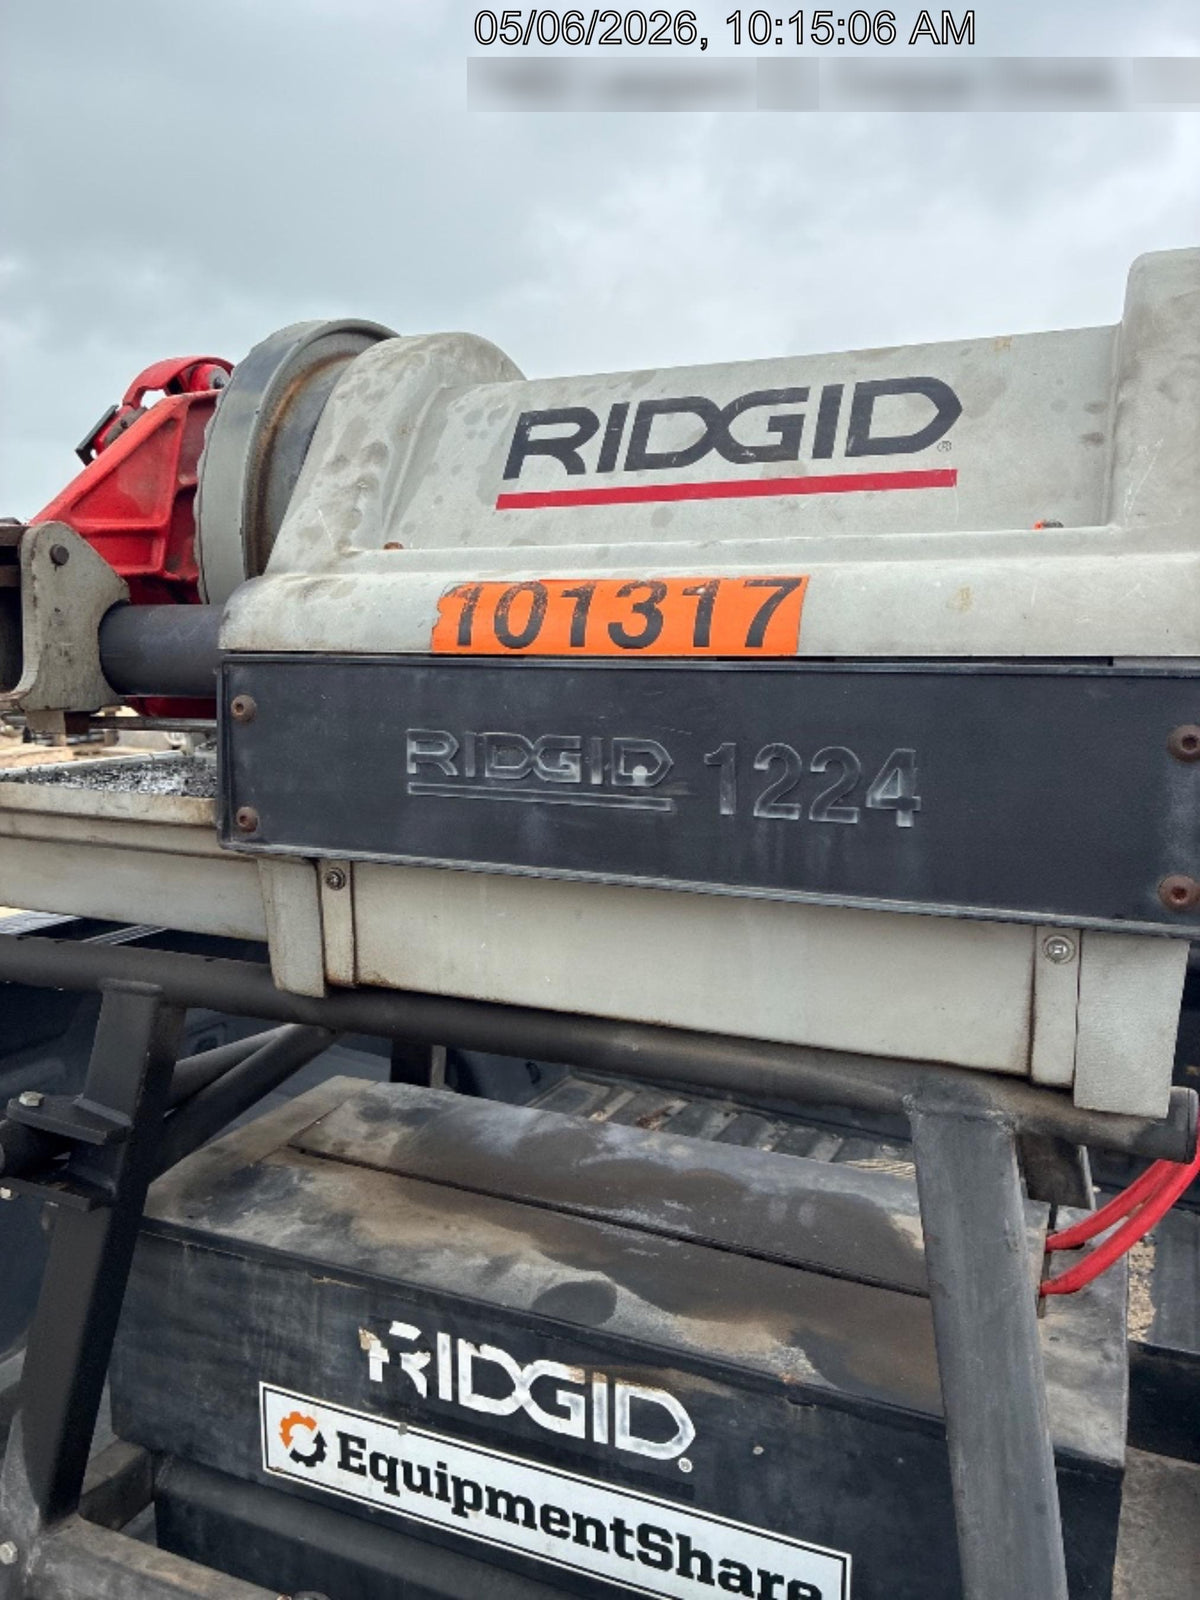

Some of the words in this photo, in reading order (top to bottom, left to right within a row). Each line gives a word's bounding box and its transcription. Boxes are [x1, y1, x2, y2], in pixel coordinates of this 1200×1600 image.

[503, 376, 962, 480] RIDGID
[441, 576, 803, 650] 101317
[406, 728, 674, 787] RIDGID
[704, 742, 922, 828] 1224
